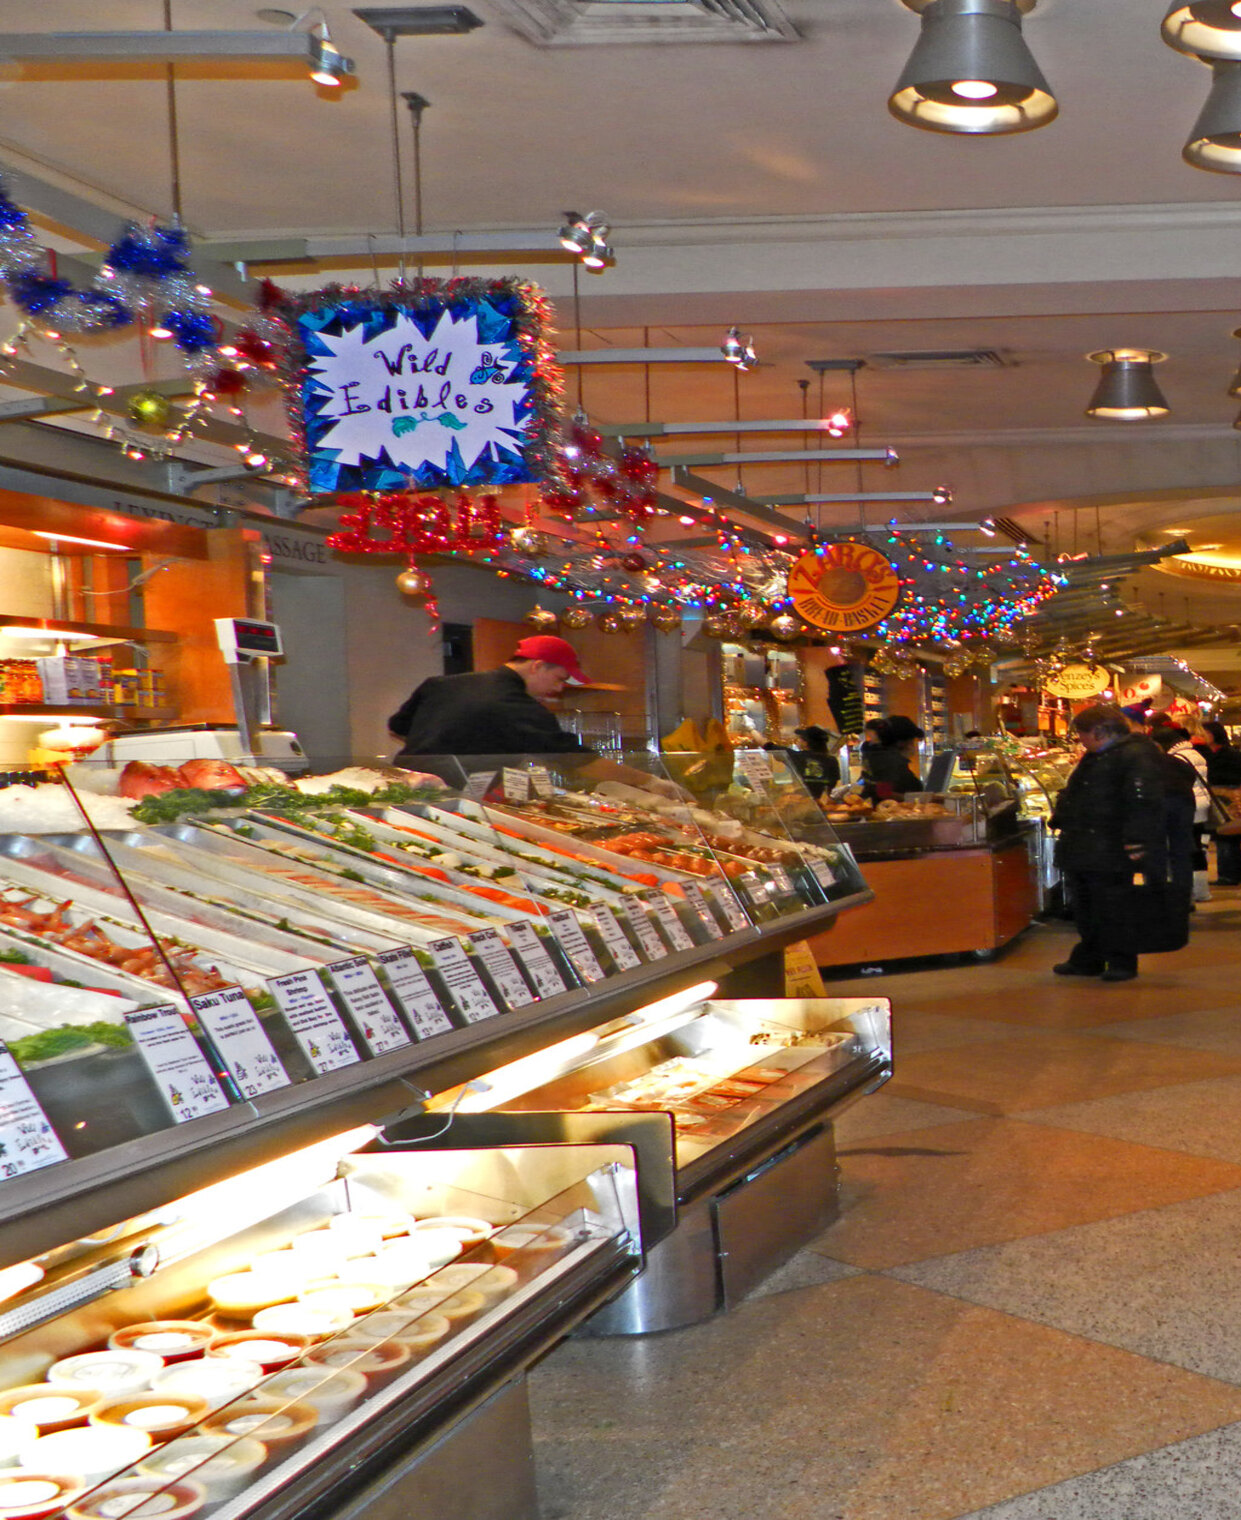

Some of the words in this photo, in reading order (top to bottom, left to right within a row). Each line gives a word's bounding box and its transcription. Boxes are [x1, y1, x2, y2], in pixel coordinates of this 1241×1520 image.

[373, 343, 452, 376] Wild
[338, 381, 494, 416] Edibles
[264, 533, 327, 563] ASSAGE
[192, 999, 220, 1011] Saku
[219, 991, 245, 1004] Tuna
[124, 1012, 158, 1024] Rainbow
[245, 1085, 257, 1096] 23
[181, 1108, 193, 1119] 12
[1, 1162, 18, 1177] 20
